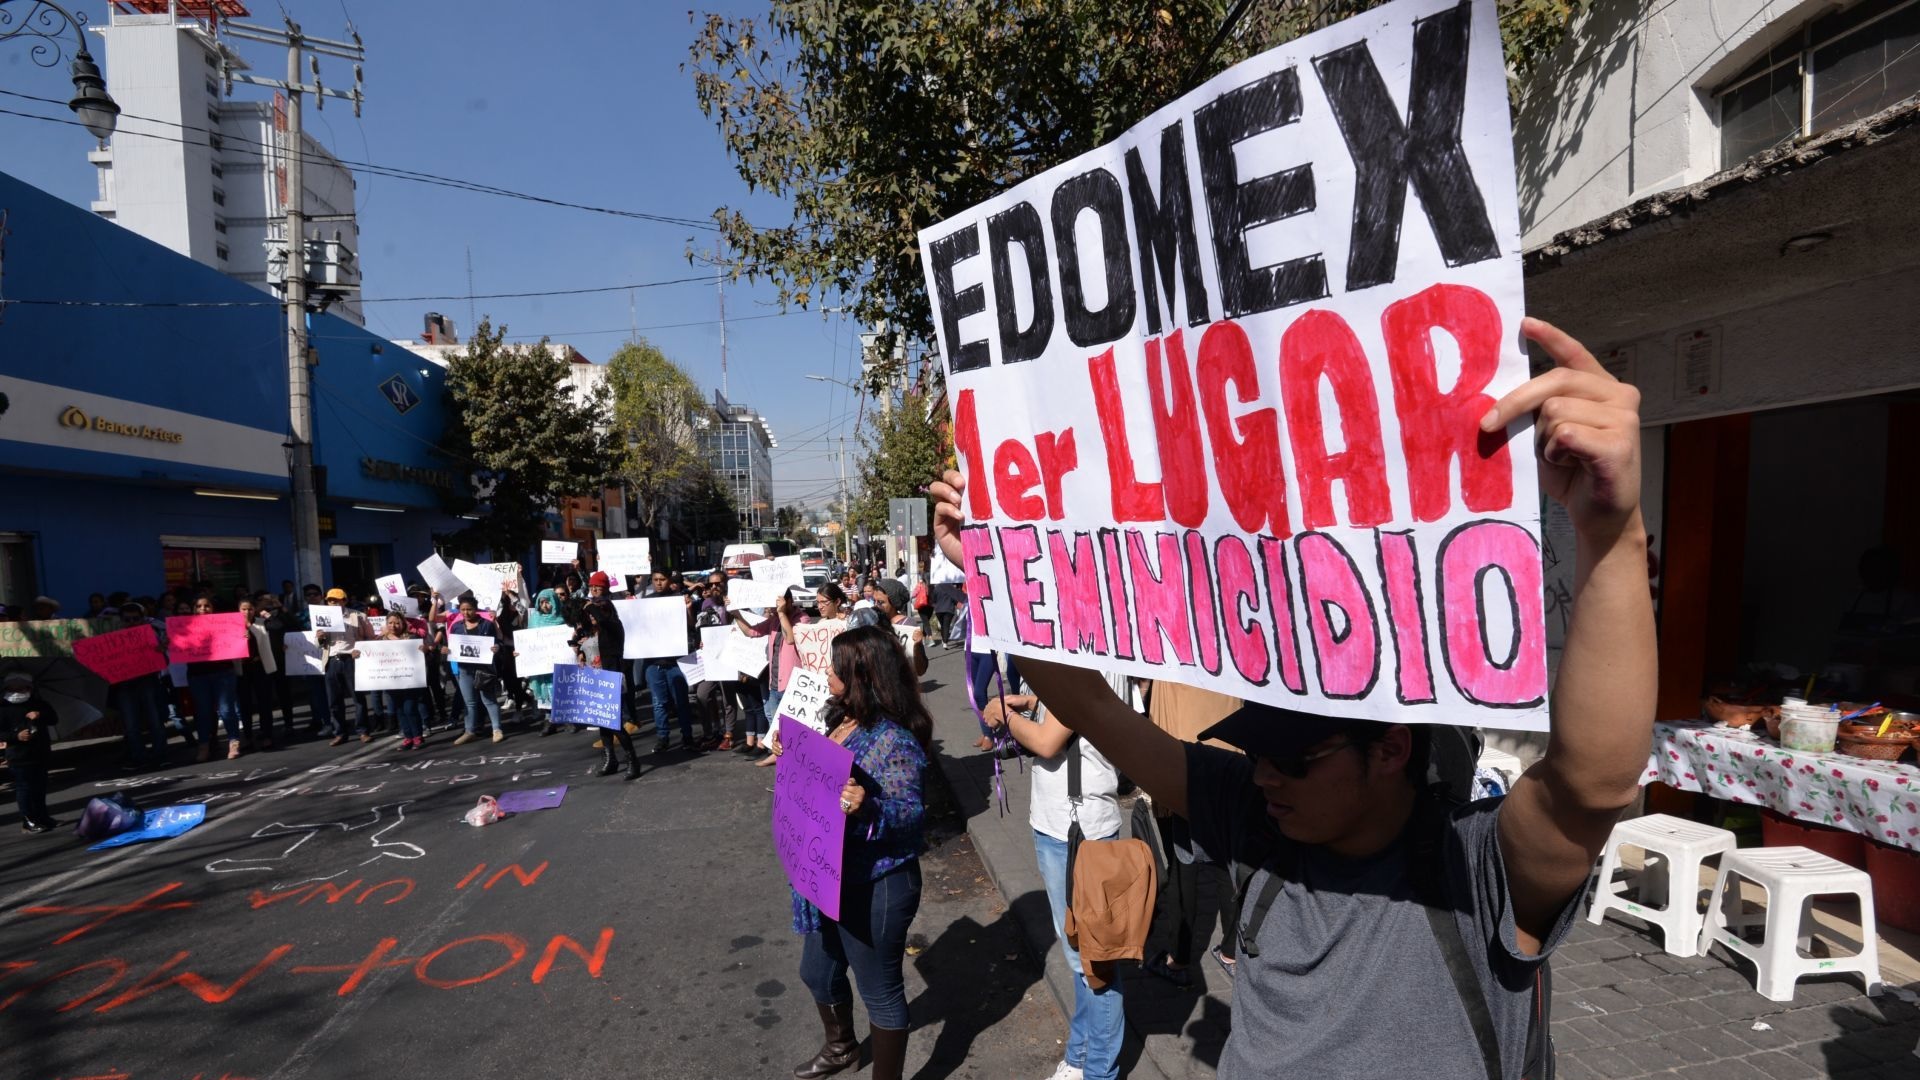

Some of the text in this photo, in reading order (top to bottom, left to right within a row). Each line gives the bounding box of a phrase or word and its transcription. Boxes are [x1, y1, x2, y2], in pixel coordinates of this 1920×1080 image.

[930, 2, 1501, 374] EDOMEX
[953, 283, 1514, 540] 1er LUGAR
[96, 416, 185, 443] Banco Azteca
[961, 519, 1548, 709] FEMINICIDIO
[558, 669, 615, 689] Justicia para
[797, 674, 829, 694] GRIT
[456, 861, 549, 889] NI
